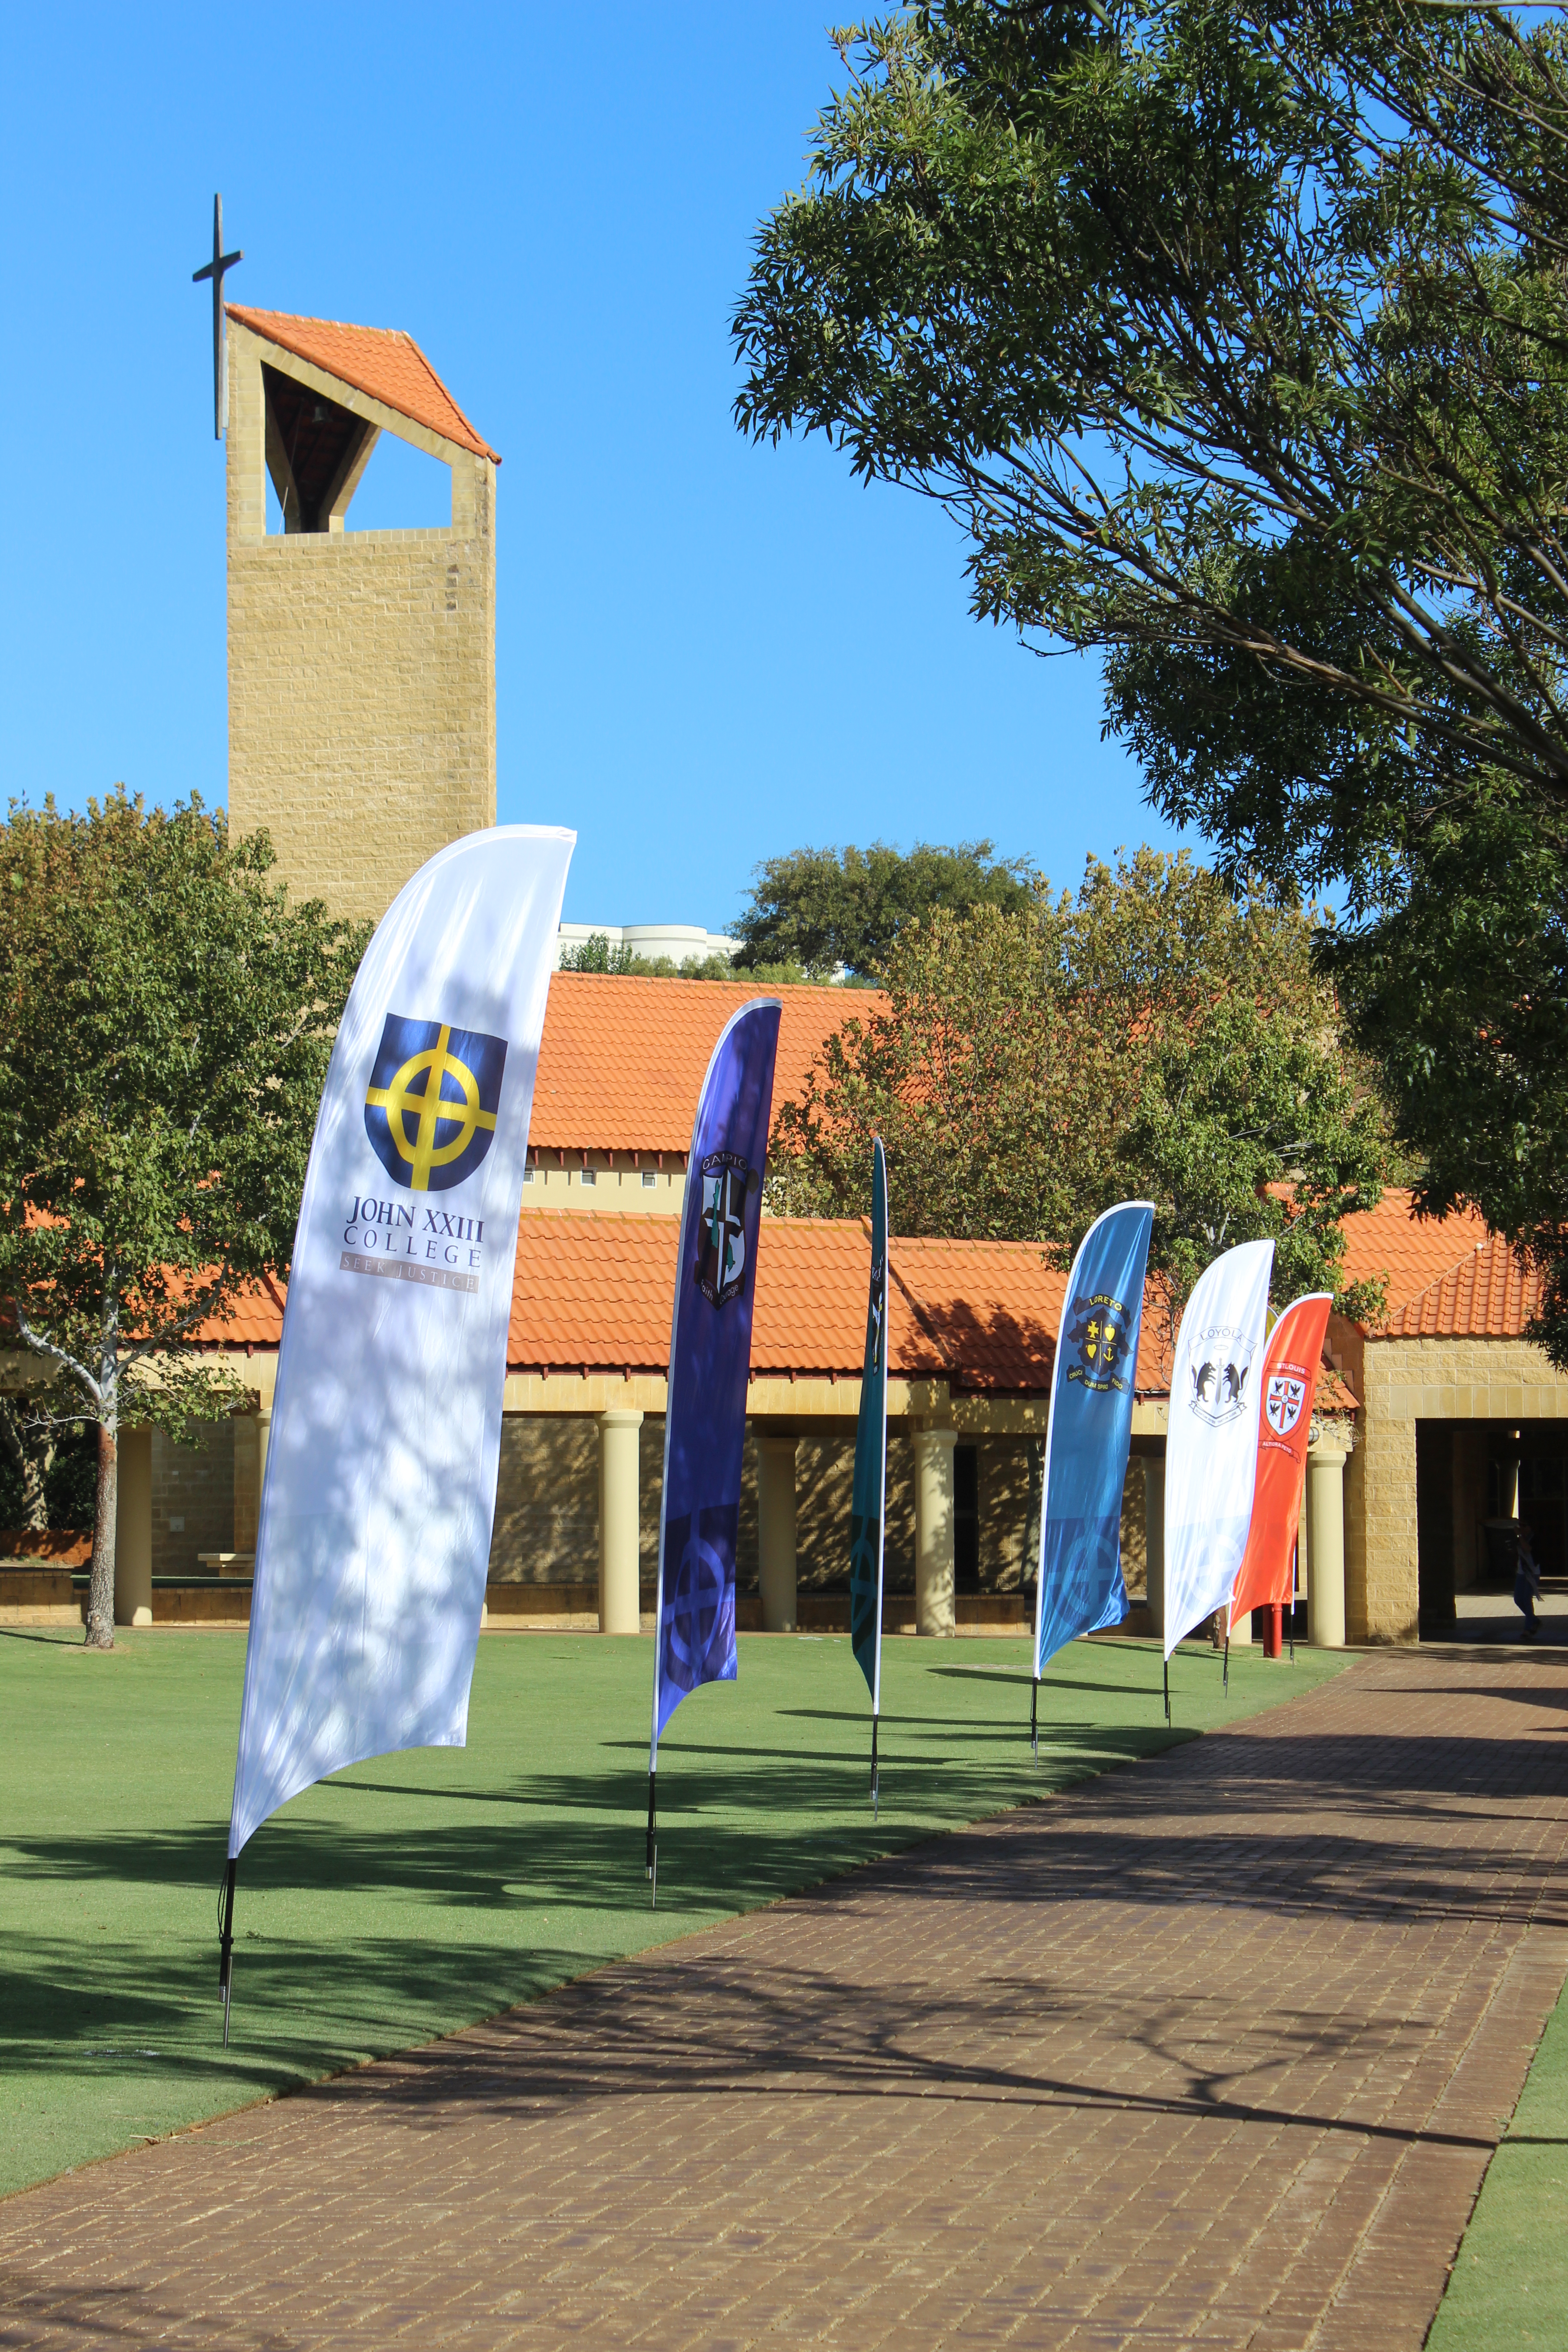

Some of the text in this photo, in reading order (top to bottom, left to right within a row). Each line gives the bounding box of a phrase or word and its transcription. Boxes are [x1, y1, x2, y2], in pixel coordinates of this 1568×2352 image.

[703, 1153, 747, 1171] CAMPIO
[346, 1196, 485, 1243] JOHN XXIII
[344, 1226, 482, 1268] COLLEGE
[343, 1256, 475, 1290] SEEK JUSTICE
[1089, 1295, 1122, 1311] LORETO
[1200, 1328, 1242, 1342] LOYOLA
[1069, 1370, 1083, 1379] CRUCI
[1084, 1379, 1097, 1388] DUM
[1112, 1378, 1123, 1389] FIDO
[1281, 1444, 1292, 1453] PETO
